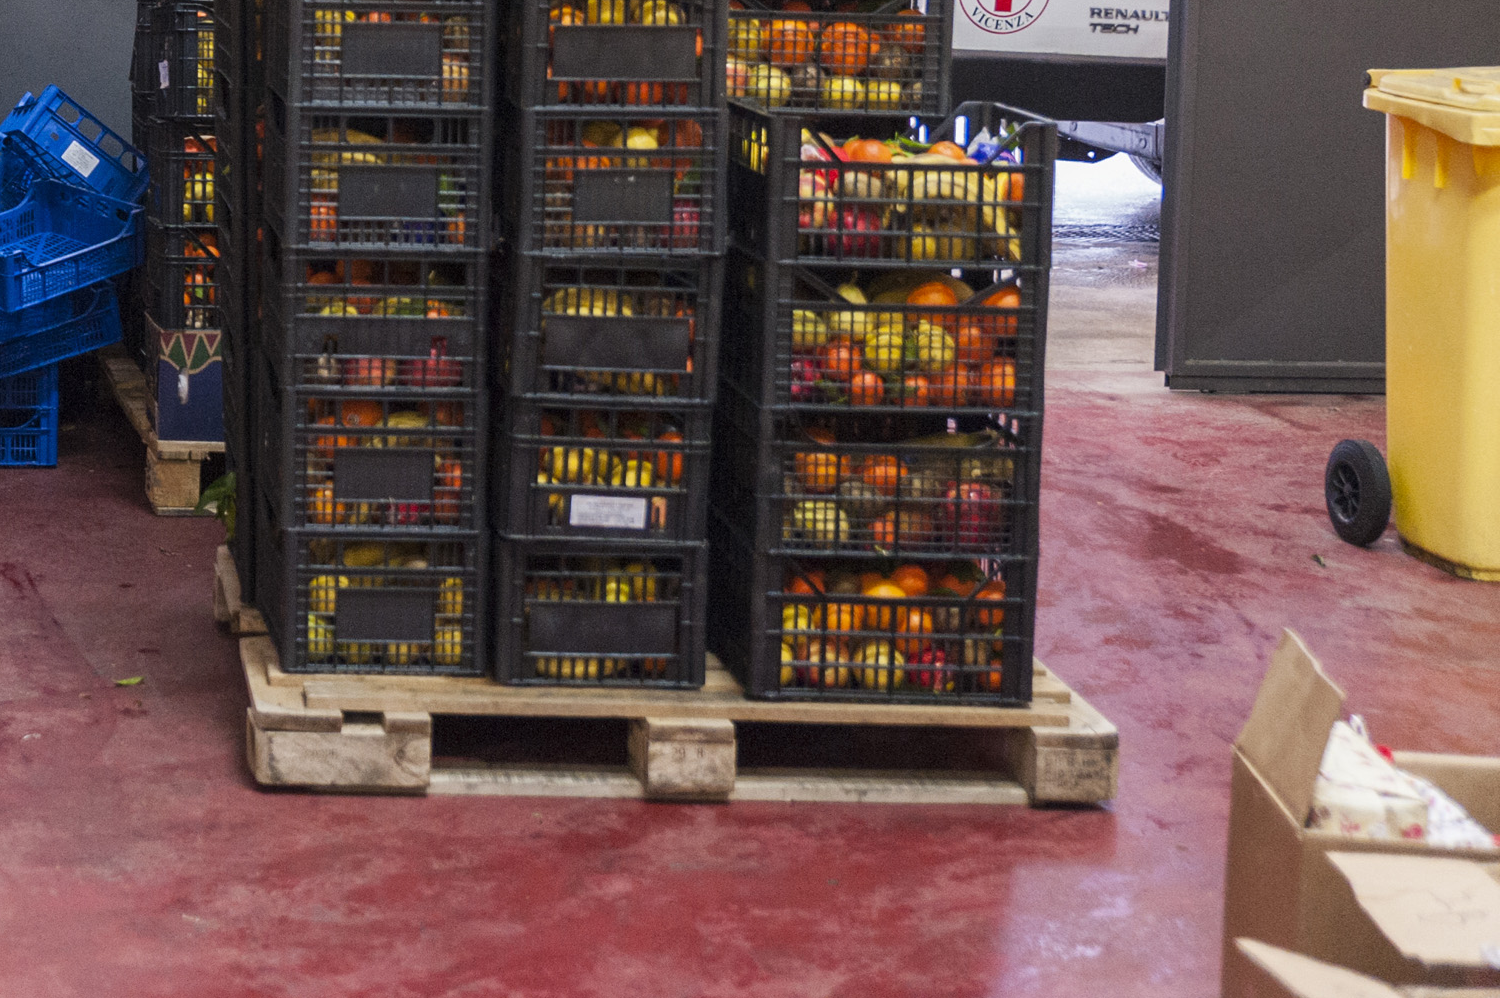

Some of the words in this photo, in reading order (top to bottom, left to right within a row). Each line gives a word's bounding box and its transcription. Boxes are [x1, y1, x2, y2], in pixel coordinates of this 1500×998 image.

[972, 6, 1034, 30] VICENZA
[1089, 7, 1170, 22] RENAULT
[1089, 22, 1140, 34] TECH
